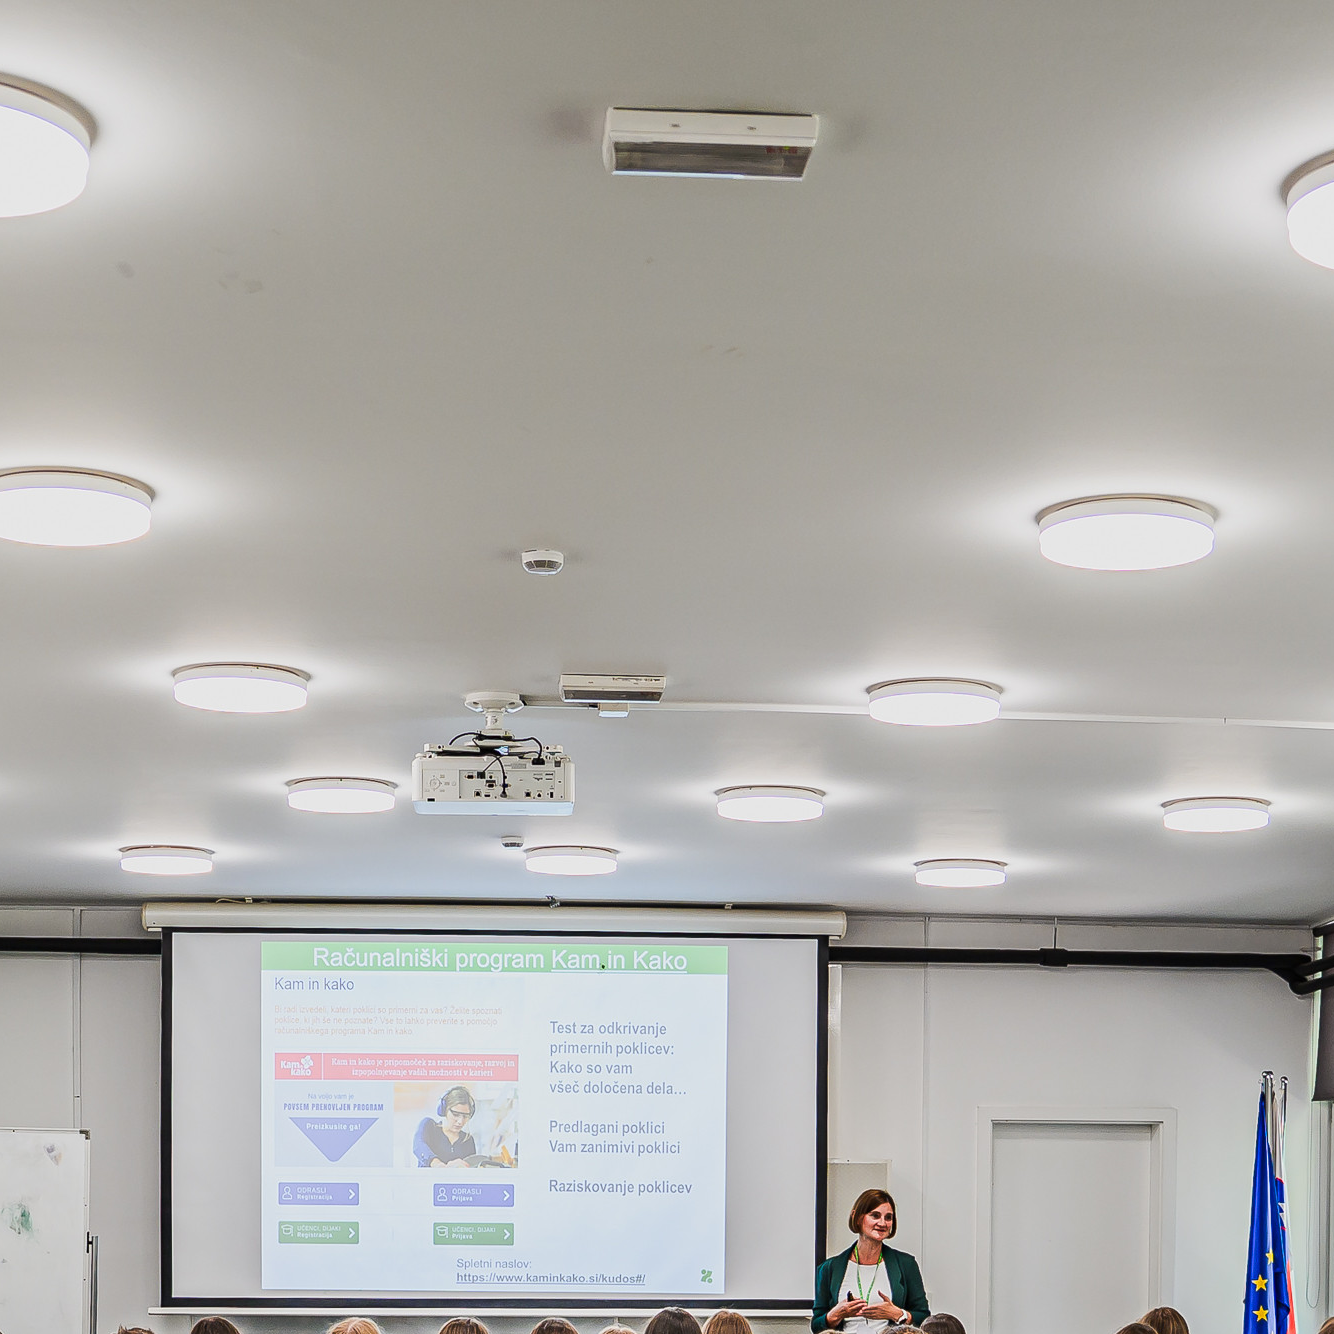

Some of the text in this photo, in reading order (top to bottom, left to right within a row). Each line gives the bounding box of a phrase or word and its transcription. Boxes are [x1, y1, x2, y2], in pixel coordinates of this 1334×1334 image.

[313, 948, 687, 972] Računalniški program Kam in Kako
[275, 977, 354, 991] Kam in kako
[284, 1005, 297, 1013] radi
[331, 1006, 350, 1014] kateri
[353, 1006, 375, 1016] poklici
[389, 1006, 417, 1016] primerni
[380, 1017, 393, 1025] Vse
[396, 1017, 402, 1025] to
[405, 1017, 424, 1025] lahko
[550, 1021, 667, 1038] Test za odkrivanje
[550, 1041, 674, 1057] primernih poklicev:
[331, 1058, 348, 1066] Kam
[349, 1058, 357, 1066] in
[358, 1058, 375, 1066] kako
[376, 1058, 383, 1068] je
[384, 1058, 426, 1067] pripomoček
[550, 1060, 633, 1074] Kako so vam
[291, 1068, 311, 1076] kako
[429, 1068, 462, 1077] možnosti
[549, 1080, 579, 1093] všeč
[583, 1081, 643, 1094] določena
[319, 1093, 332, 1101] voljo
[348, 1093, 354, 1101] je
[311, 1103, 351, 1111] PRENOVLJEN
[306, 1122, 361, 1131] Preizkusite ga!
[549, 1120, 665, 1136] Predlagani poklici
[549, 1140, 680, 1156] Vam zanimivi poklici
[549, 1179, 692, 1196] Raziskovanje poklicev
[457, 1258, 532, 1270] Spletni naslov:
[457, 1272, 645, 1285] https://www.kaminkako.si/kudos#/
